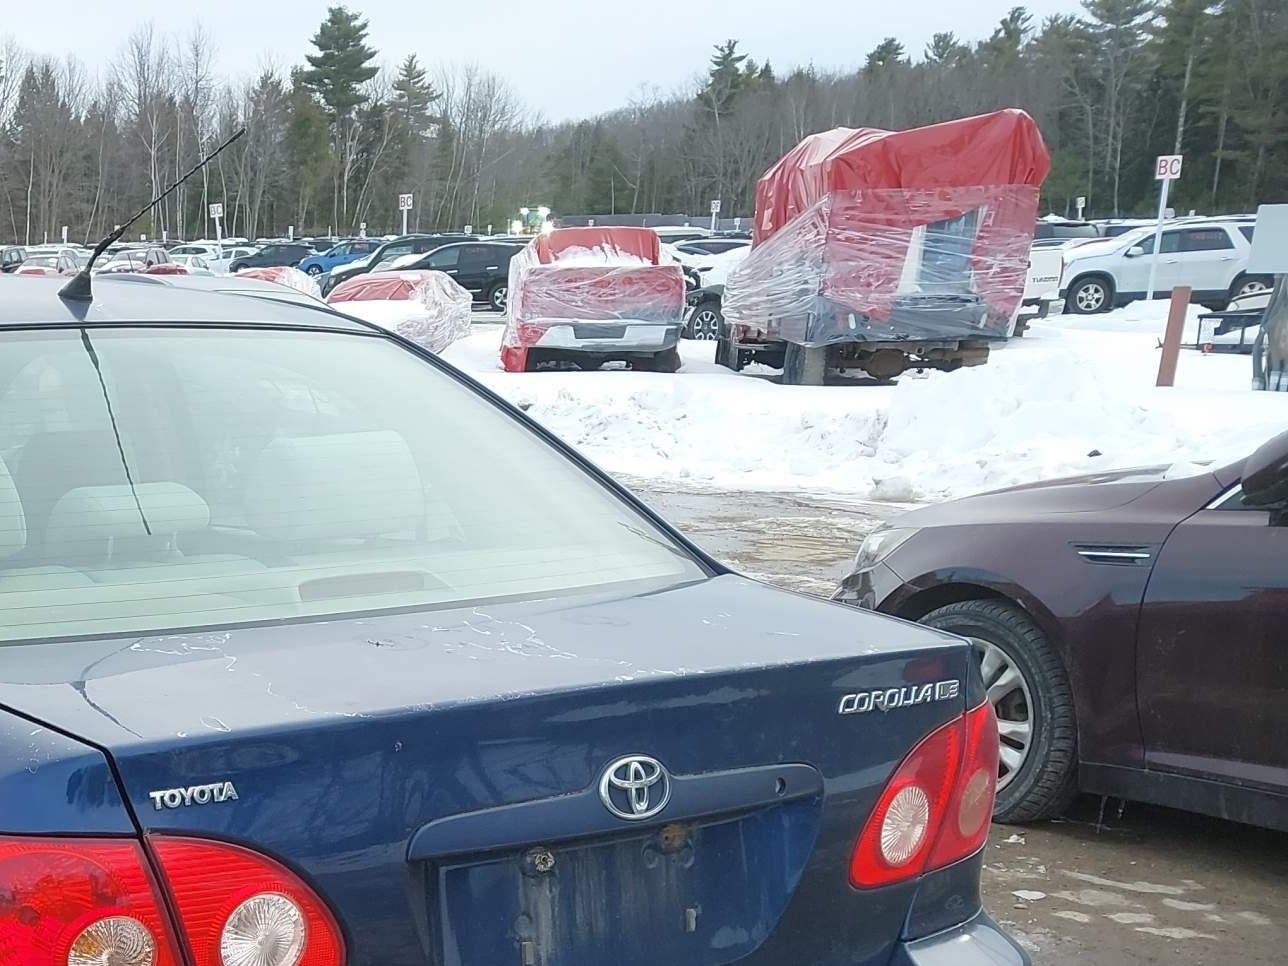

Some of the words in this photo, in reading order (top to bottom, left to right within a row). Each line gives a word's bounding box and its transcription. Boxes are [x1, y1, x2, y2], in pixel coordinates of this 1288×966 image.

[1158, 159, 1181, 176] BC
[210, 205, 222, 216] BC
[400, 196, 412, 208] BC
[838, 683, 934, 714] COROLLA
[149, 781, 239, 810] TOYOTA
